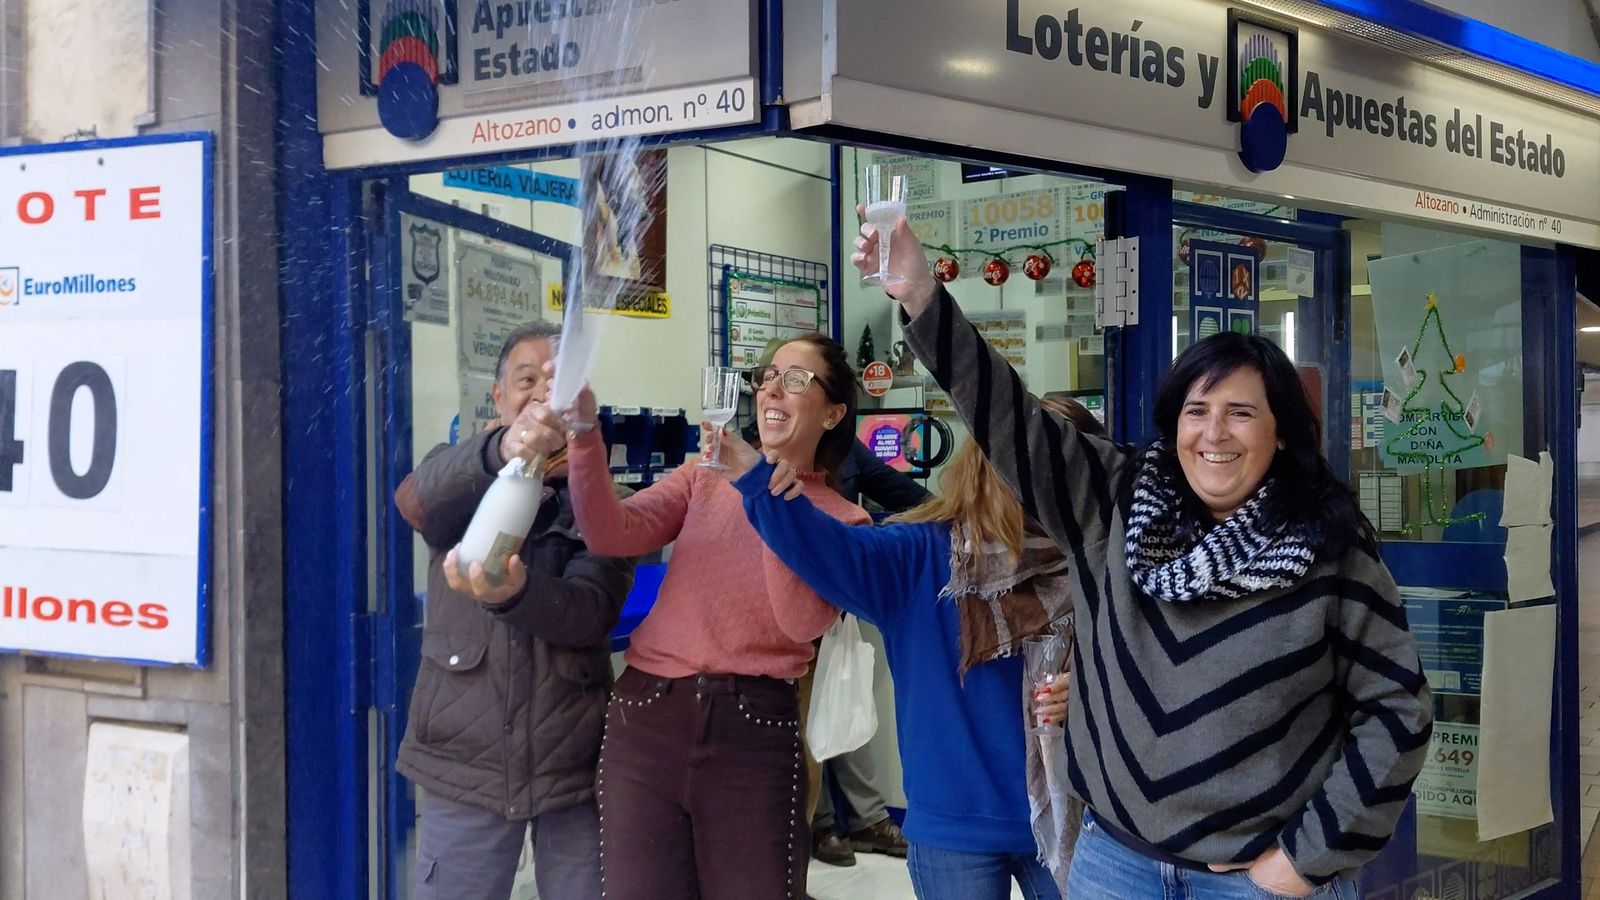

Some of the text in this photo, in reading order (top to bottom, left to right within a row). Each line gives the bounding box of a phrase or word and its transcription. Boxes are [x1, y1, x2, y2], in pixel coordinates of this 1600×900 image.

[474, 42, 581, 81] Estado
[1006, 0, 1566, 178] Loterías y Apuestas del Estado
[471, 117, 562, 144] Altozano
[591, 105, 674, 130] admon.
[716, 87, 745, 114] 40
[518, 174, 577, 199] VIAJERA
[16, 185, 162, 225] OTE
[910, 209, 945, 221] PREMIO
[970, 195, 1053, 227] 10058
[1415, 191, 1459, 214] Altozano
[1470, 203, 1535, 230] Administración
[1551, 219, 1562, 234] 40
[989, 222, 1049, 243] Premio
[24, 273, 136, 296] EuroMillones
[1411, 426, 1437, 436] CON
[1397, 454, 1462, 465] MAOLTA
[3, 586, 169, 630] llones
